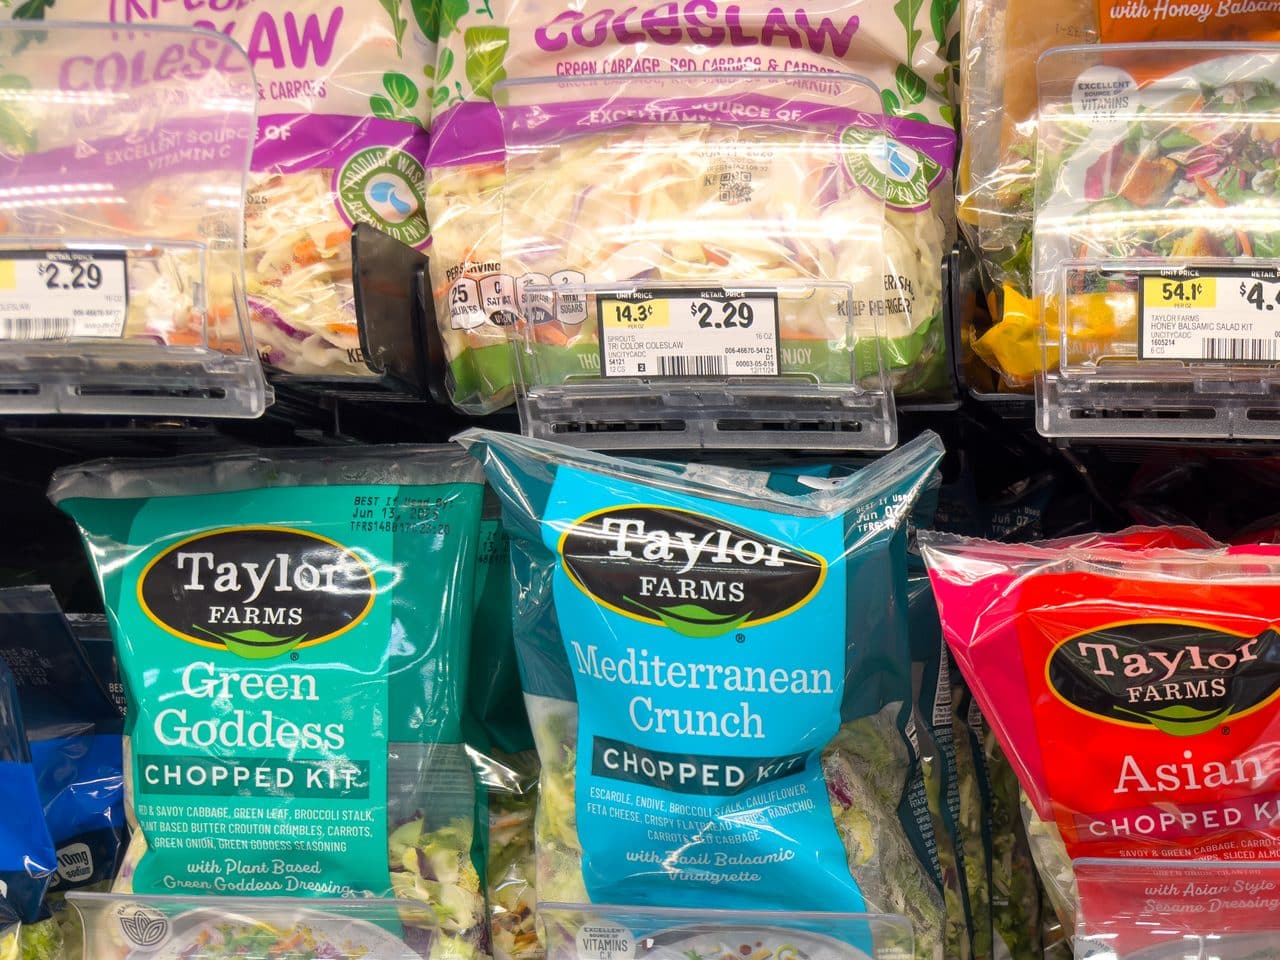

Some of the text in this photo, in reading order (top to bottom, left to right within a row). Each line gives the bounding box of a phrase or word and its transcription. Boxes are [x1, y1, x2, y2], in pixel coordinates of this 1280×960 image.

[1110, 1, 1150, 20] with
[1154, 0, 1211, 22] Honey
[38, 263, 103, 290] $2.29
[1162, 280, 1203, 301] 54.1¢
[615, 304, 654, 323] 14.3¢
[690, 303, 754, 329] $2.29
[1151, 322, 1253, 331] HONEY BALSAMIC SALAD KIT
[646, 341, 683, 349] COLESLAW
[602, 517, 790, 575] Taylor
[177, 552, 338, 604] Taylor
[640, 577, 745, 601] FARMS
[208, 607, 303, 624] FARMS
[571, 641, 832, 694] Mediterranean
[1079, 637, 1258, 681] Taylor
[182, 661, 319, 700] Green
[1129, 679, 1226, 702] FARMS
[154, 708, 345, 749] Goddess
[629, 697, 765, 738] Crunch
[144, 765, 362, 789] CHOPPED KIT
[603, 749, 800, 787] CHOPPED KIT
[1114, 750, 1266, 793] Asian
[1089, 808, 1241, 837] CHOPPED
